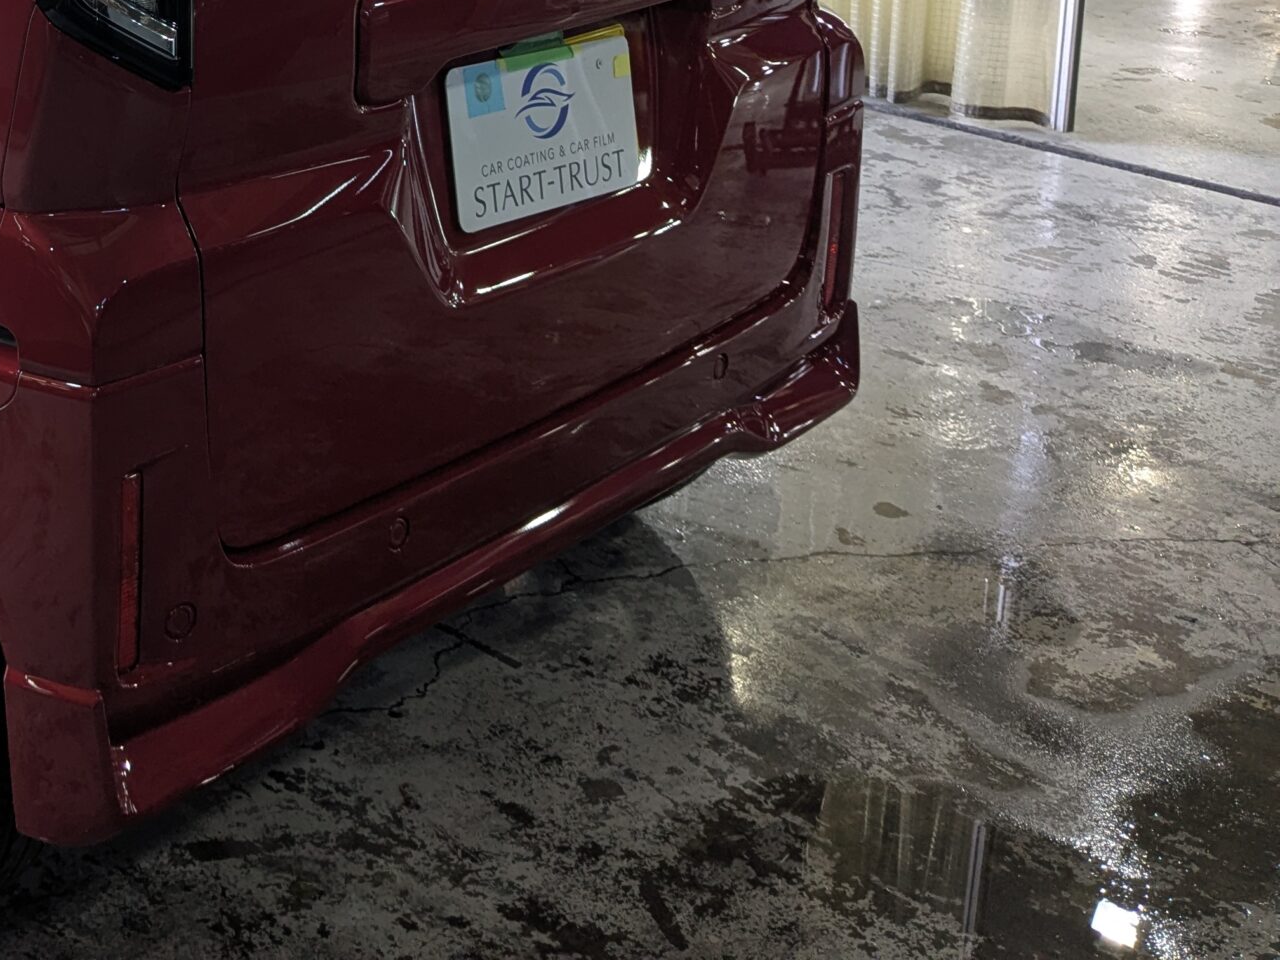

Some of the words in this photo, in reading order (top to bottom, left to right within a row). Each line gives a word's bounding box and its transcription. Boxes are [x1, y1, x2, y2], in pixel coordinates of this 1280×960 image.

[474, 149, 625, 218] START-TRUST
[481, 160, 503, 178] CAR
[507, 148, 555, 171] COATING
[559, 144, 567, 158] &
[570, 138, 590, 155] CAR
[593, 132, 616, 149] FILM
